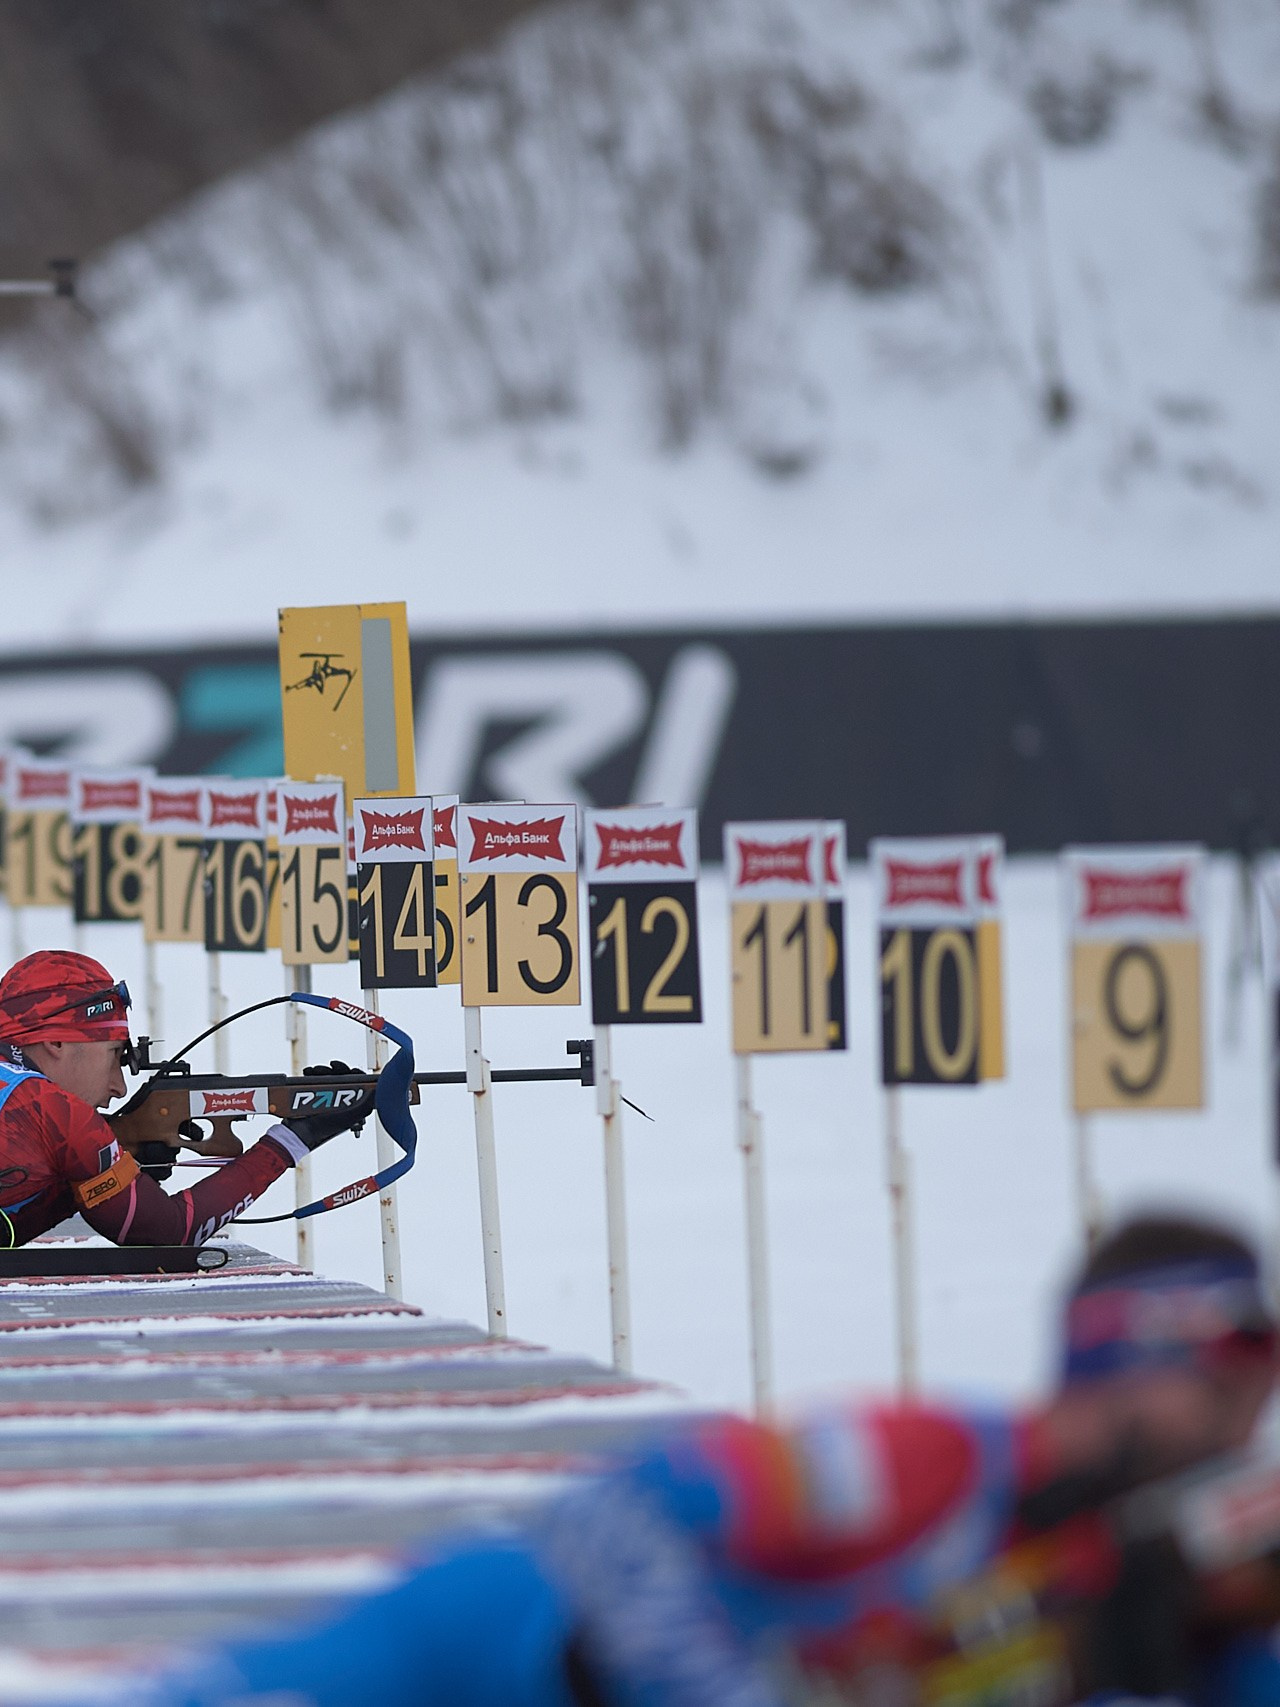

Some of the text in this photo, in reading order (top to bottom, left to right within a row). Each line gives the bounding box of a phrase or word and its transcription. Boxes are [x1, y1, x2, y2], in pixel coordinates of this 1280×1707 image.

[73, 822, 145, 919] 18
[372, 823, 415, 839] Альфа Банк
[484, 832, 550, 848] Альфа Банк
[146, 840, 204, 932] 17
[206, 840, 265, 945] 16
[283, 847, 343, 953] 15
[361, 863, 433, 977] 14
[466, 873, 573, 995] 13
[596, 896, 693, 1013] 12
[743, 903, 812, 1036] 11
[881, 927, 979, 1080] 10
[87, 1000, 114, 1017] PARI
[1102, 940, 1171, 1098] 9
[86, 1177, 118, 1201] ZERO
